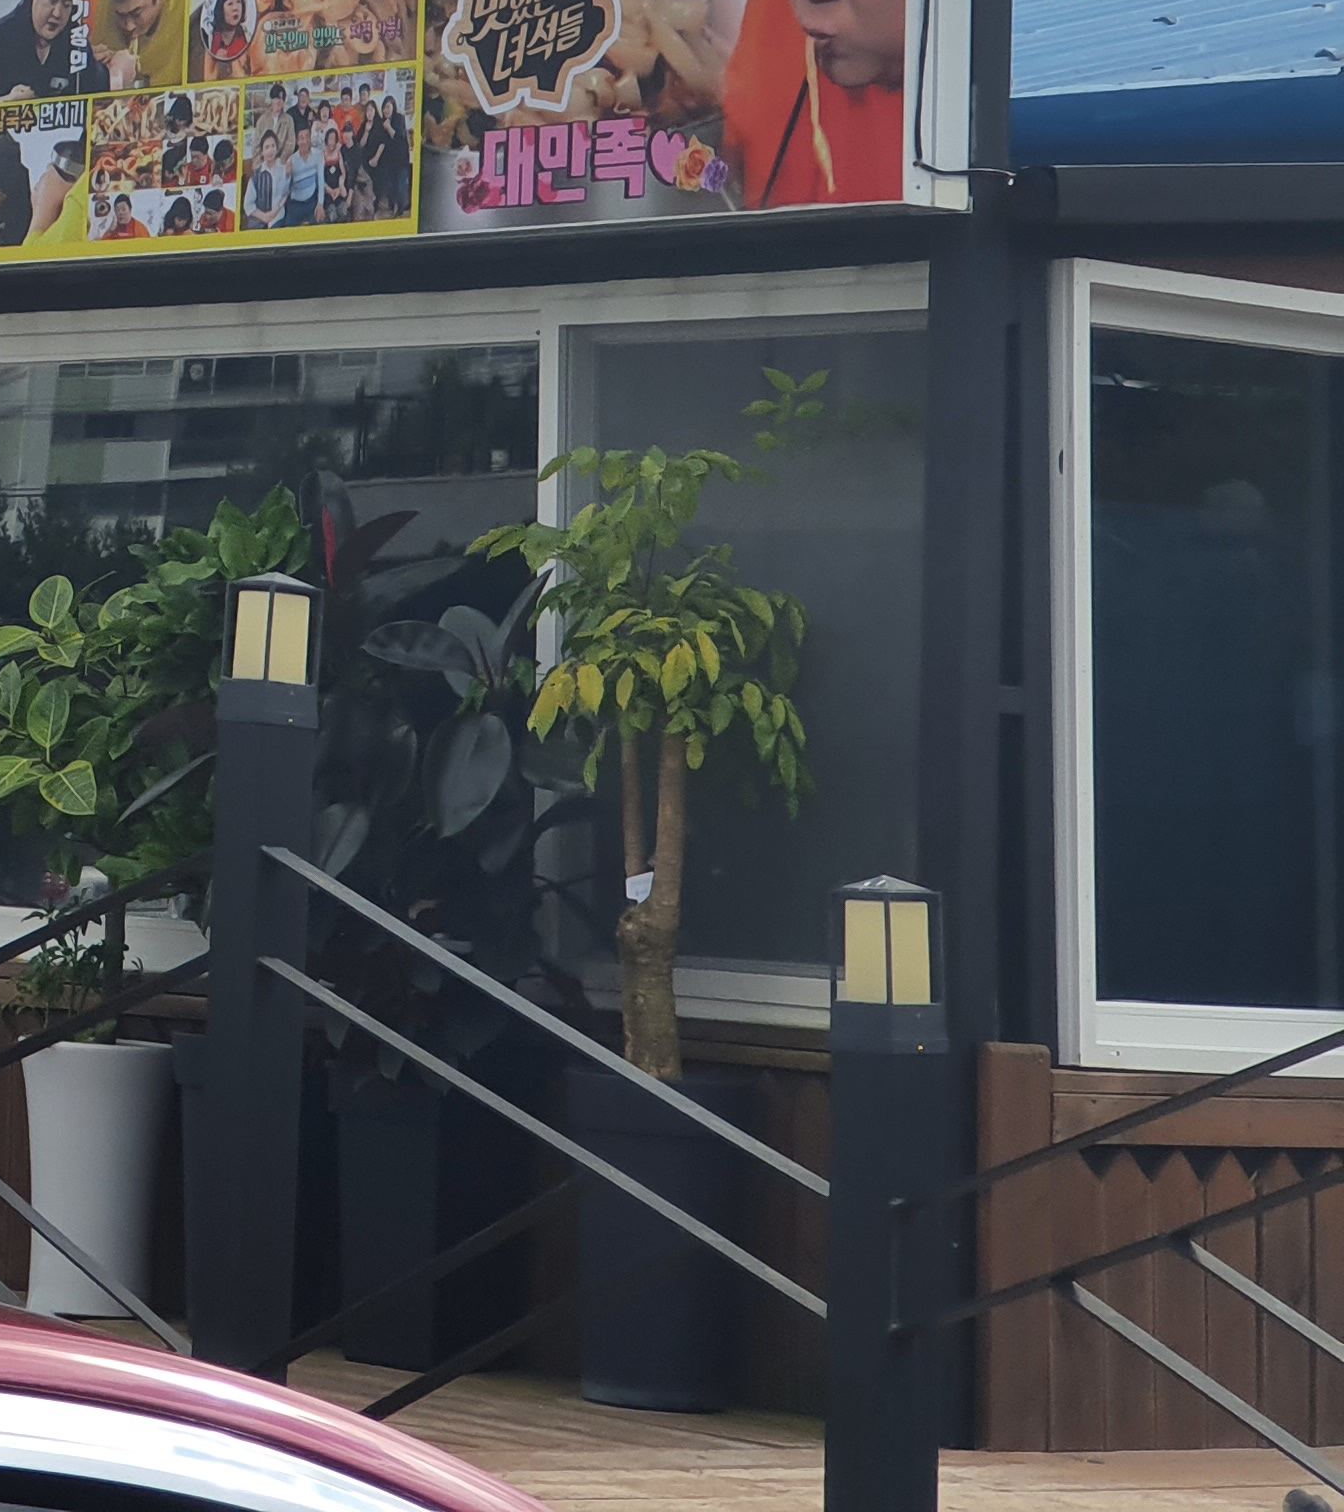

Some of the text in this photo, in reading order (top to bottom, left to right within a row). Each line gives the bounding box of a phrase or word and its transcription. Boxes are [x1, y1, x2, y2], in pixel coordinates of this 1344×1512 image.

[492, 1, 585, 82] 녀석들
[38, 101, 85, 129] 면치기
[479, 116, 647, 209] 대만족
